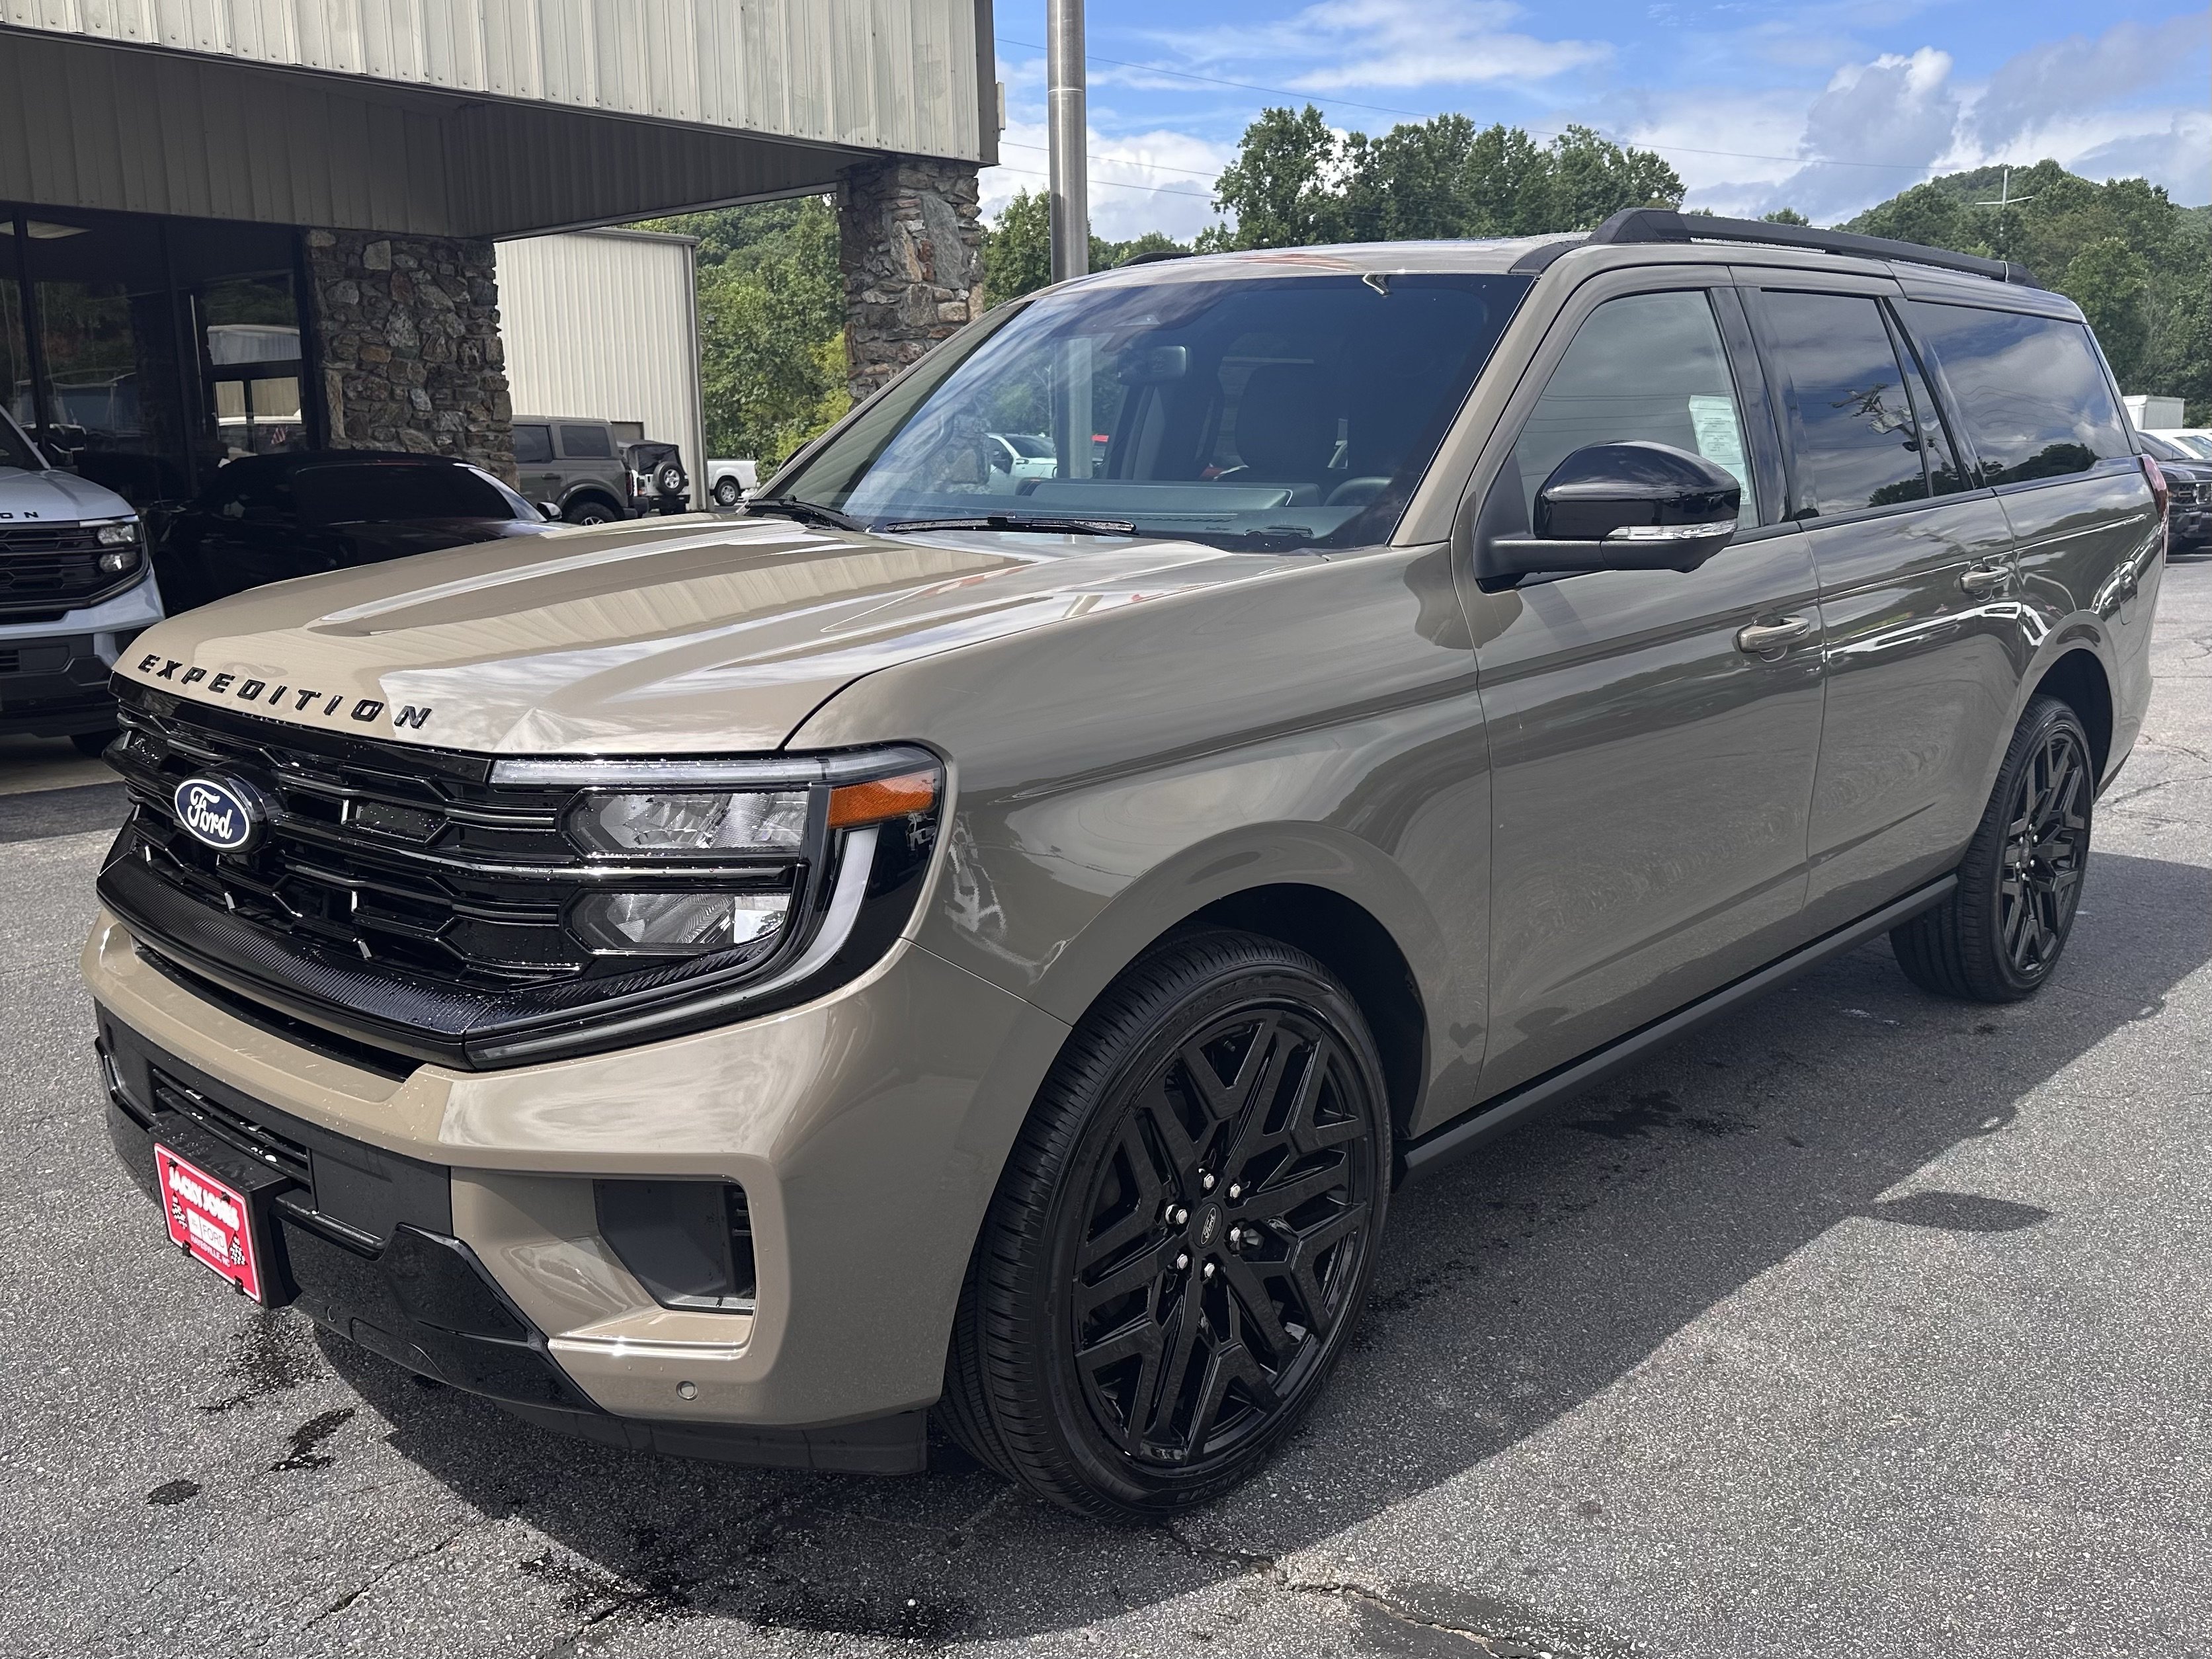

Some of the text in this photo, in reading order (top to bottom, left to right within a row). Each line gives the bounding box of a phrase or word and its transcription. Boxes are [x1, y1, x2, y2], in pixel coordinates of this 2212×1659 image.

[138, 653, 432, 729] EXPEDITION
[187, 786, 233, 839] Ford
[202, 1225, 224, 1248] FORD
[1204, 1214, 1215, 1238] Ford
